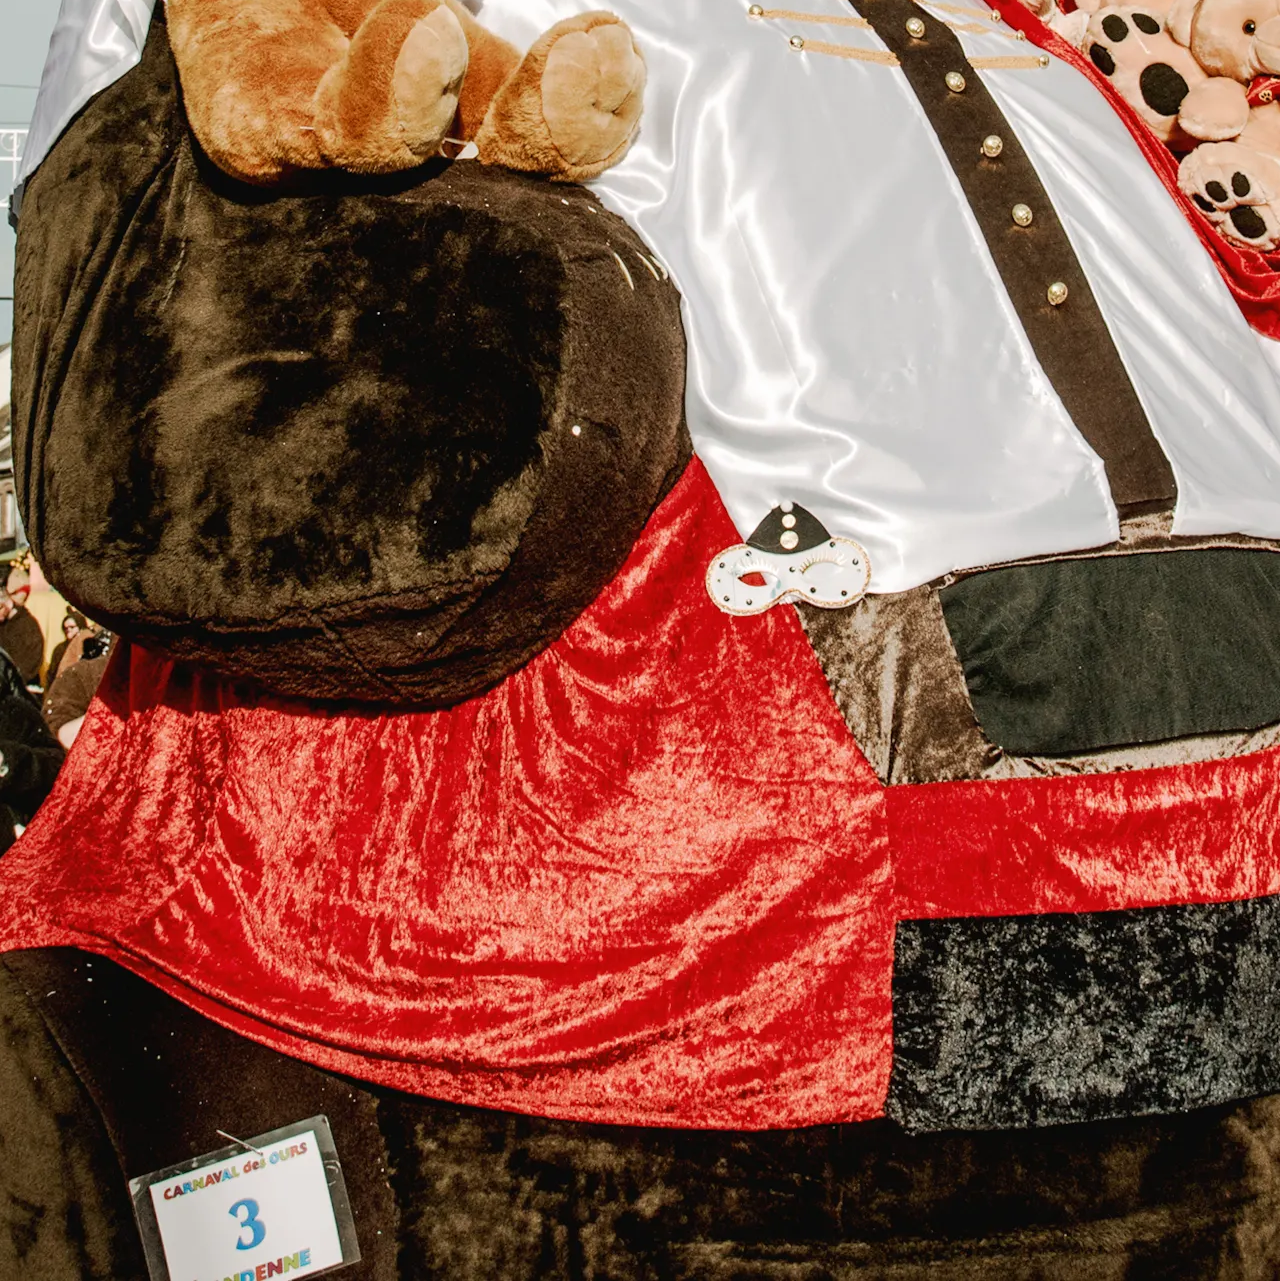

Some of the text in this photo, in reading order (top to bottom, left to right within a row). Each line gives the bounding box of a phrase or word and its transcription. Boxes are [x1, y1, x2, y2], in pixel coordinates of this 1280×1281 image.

[163, 1142, 308, 1201] CARNAVAL des OURS
[228, 1198, 266, 1250] 3
